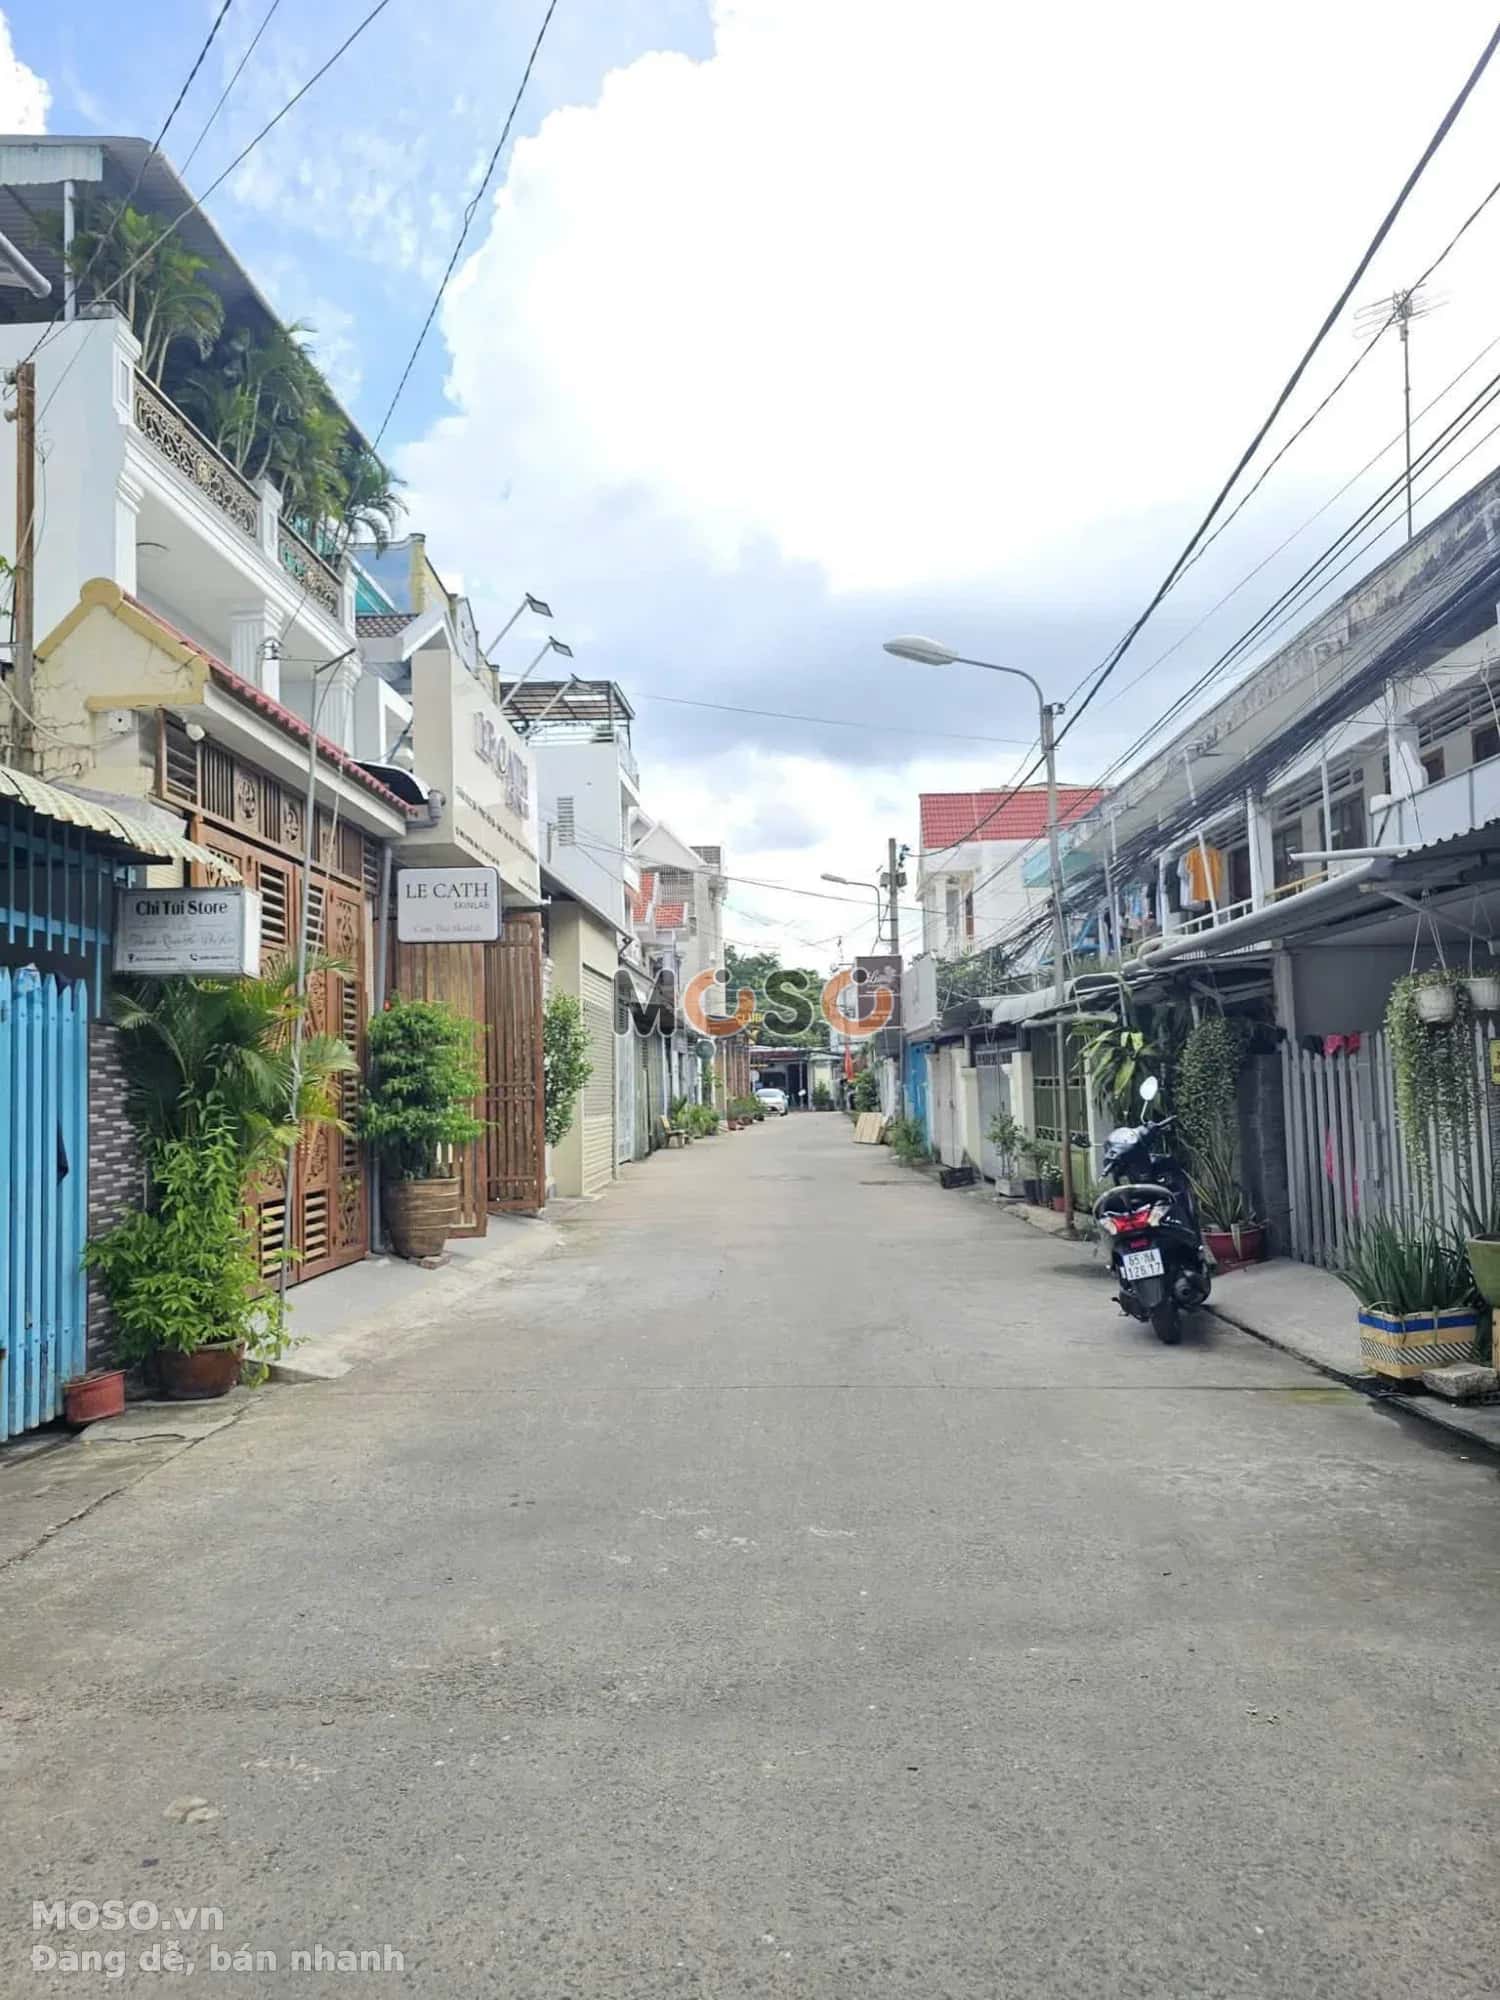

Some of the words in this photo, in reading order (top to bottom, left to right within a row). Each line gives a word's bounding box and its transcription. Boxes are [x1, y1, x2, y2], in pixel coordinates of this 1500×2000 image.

[406, 883, 428, 899] LE
[433, 882, 488, 898] CATH
[187, 899, 228, 915] Store
